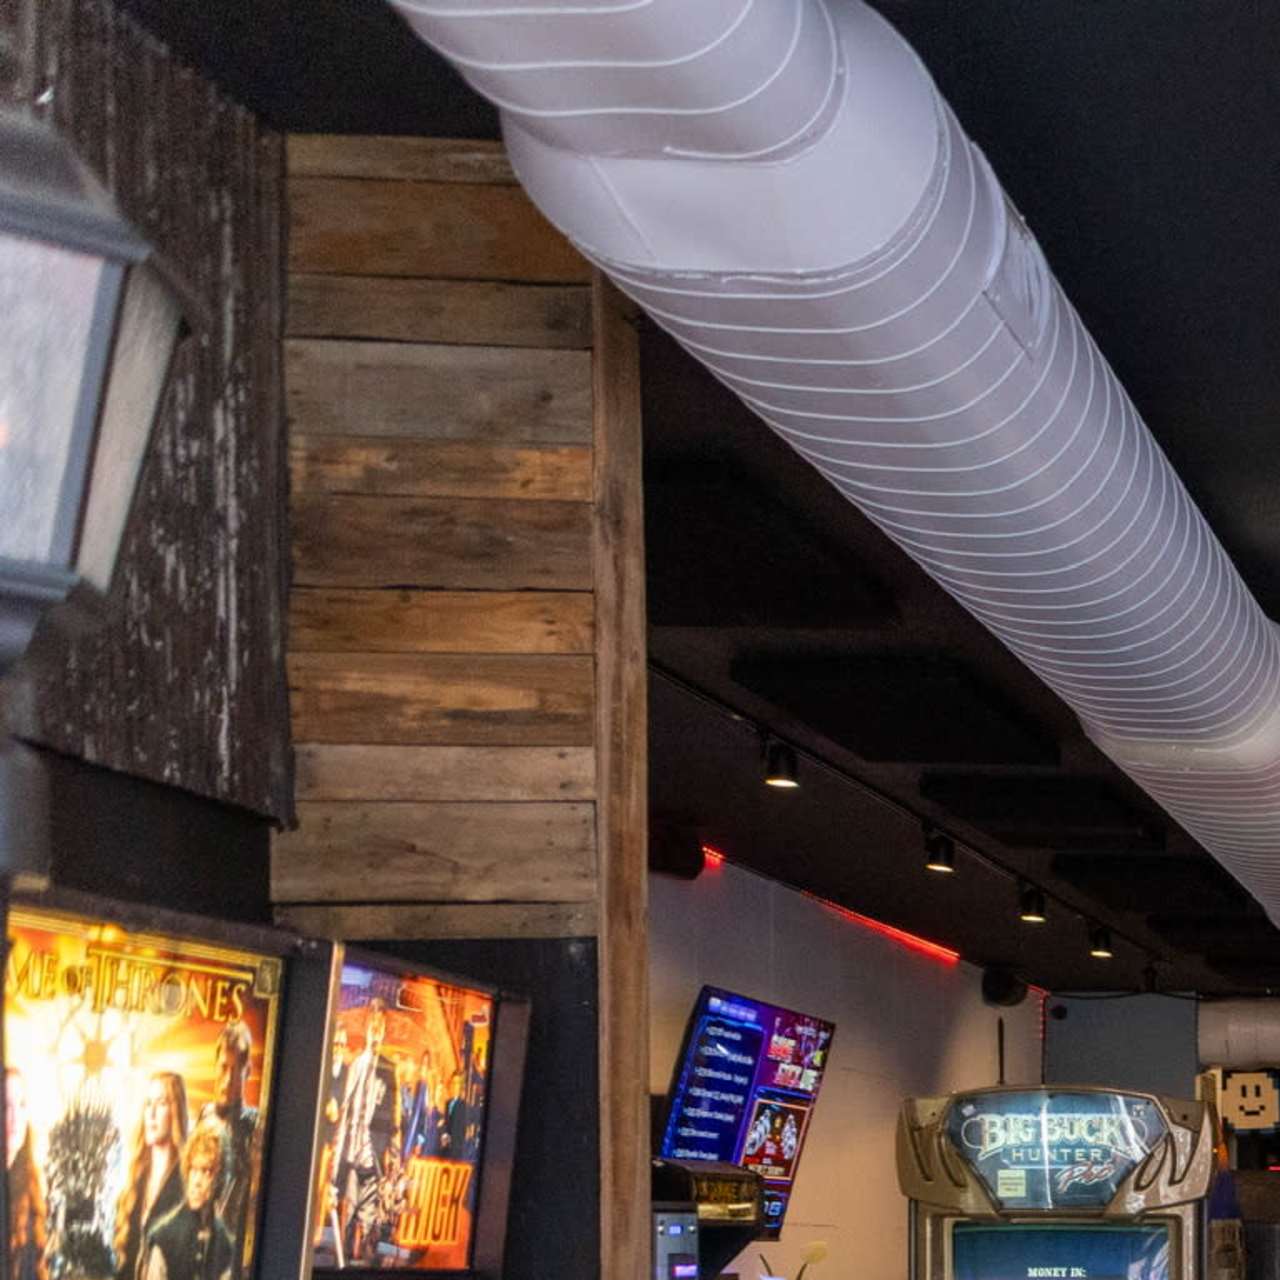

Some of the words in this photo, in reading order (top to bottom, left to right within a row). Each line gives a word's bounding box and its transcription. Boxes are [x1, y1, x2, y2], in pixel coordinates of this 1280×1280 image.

[86, 947, 254, 1024] THRONES
[977, 1113, 1037, 1153] BIG
[1046, 1113, 1130, 1153] BUCK
[1011, 1148, 1104, 1162] HUNTER
[1027, 1267, 1067, 1279] MONEY
[1070, 1267, 1087, 1279] IN:
